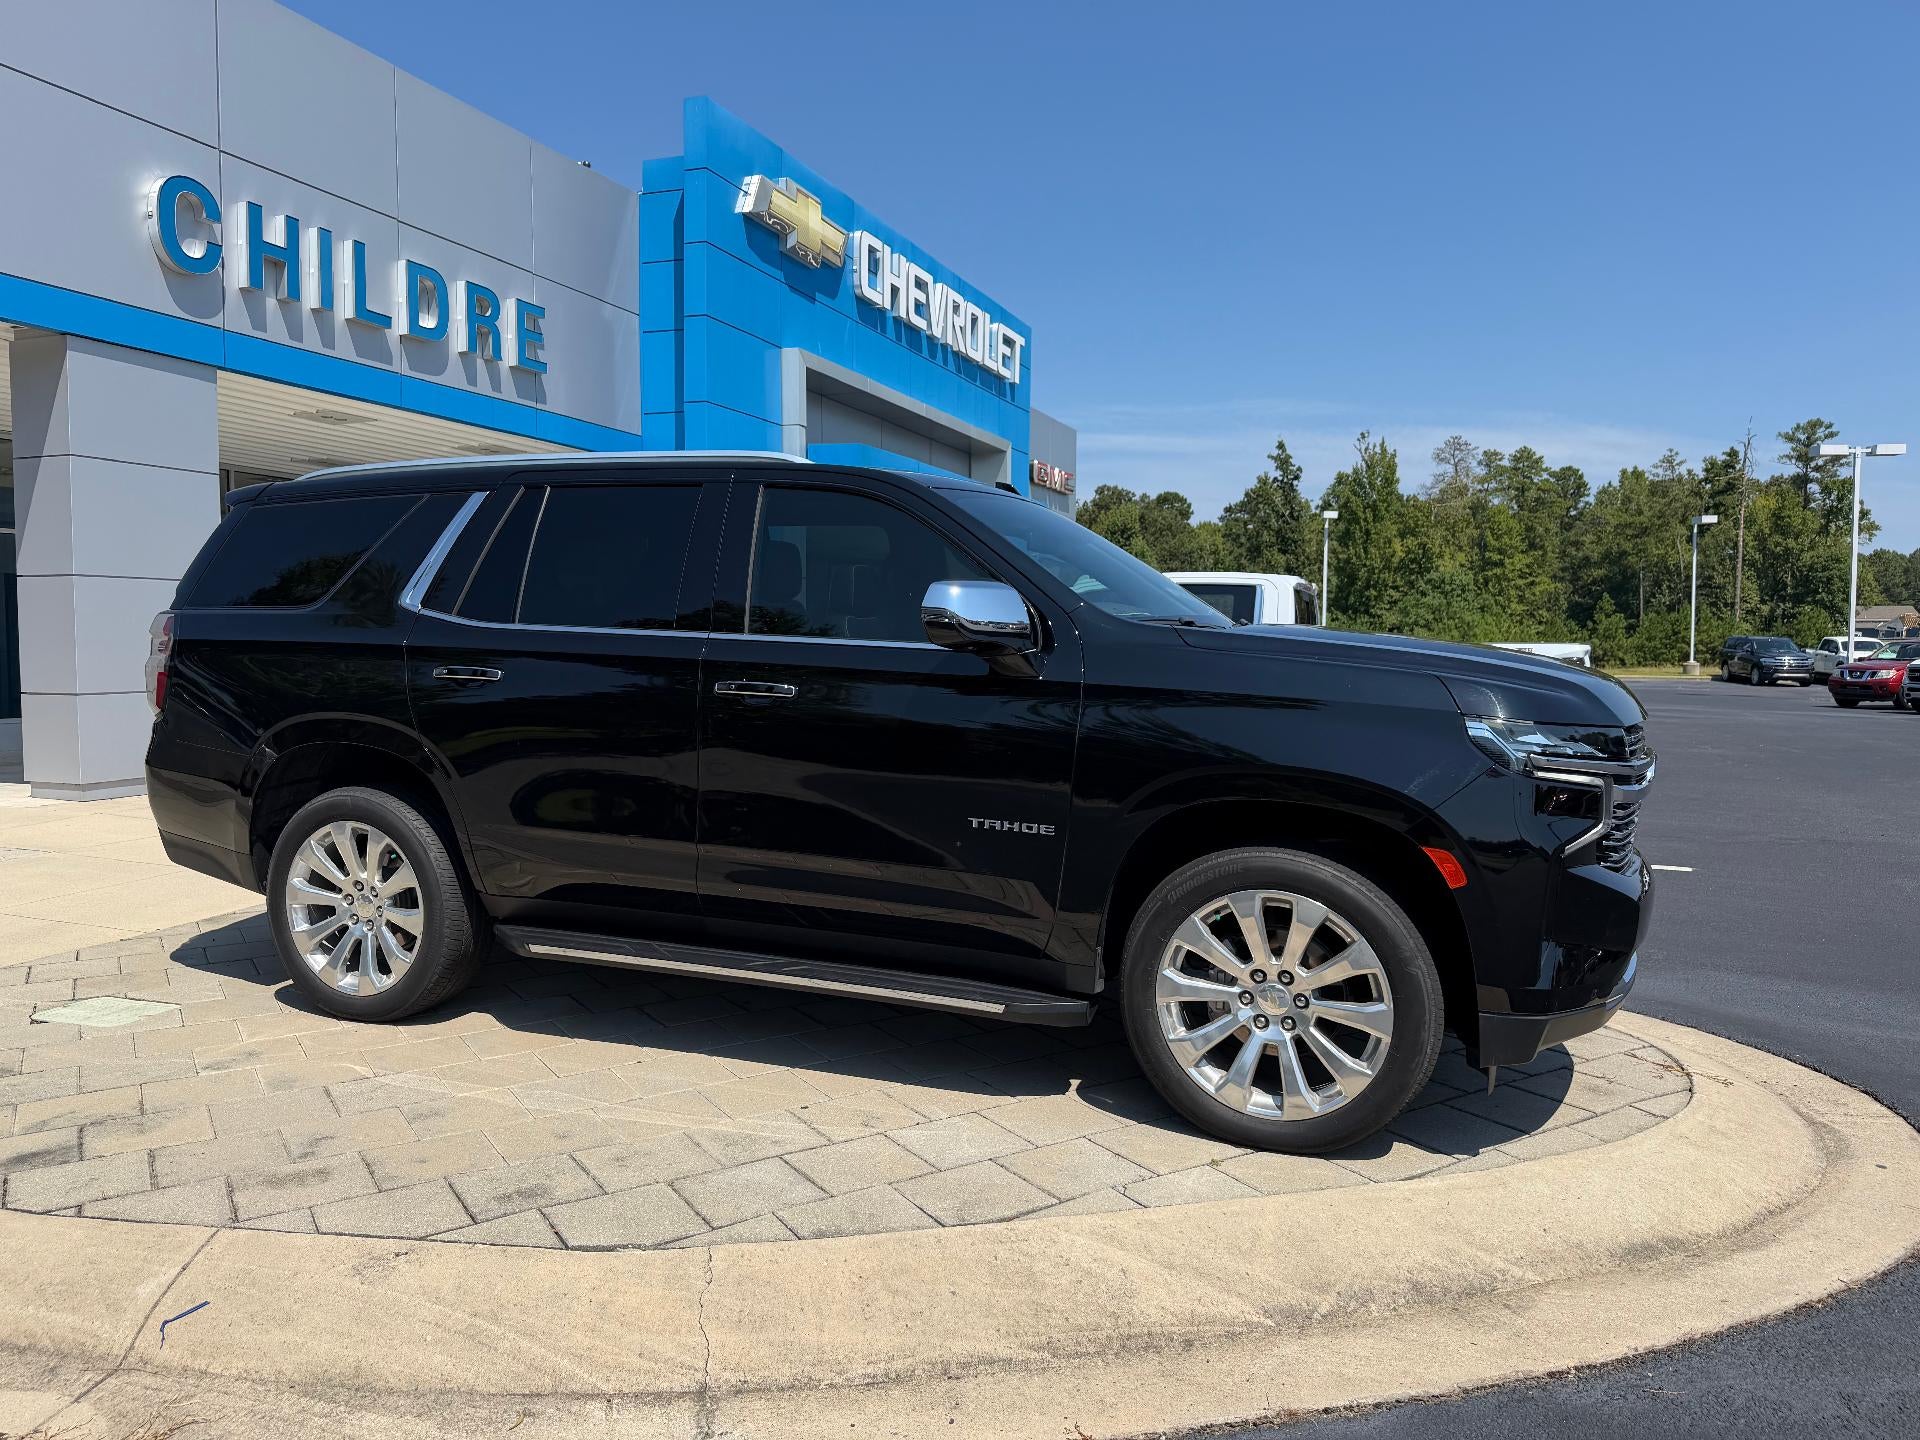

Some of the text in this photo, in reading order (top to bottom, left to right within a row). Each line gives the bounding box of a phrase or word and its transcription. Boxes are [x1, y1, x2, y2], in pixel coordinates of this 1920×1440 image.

[149, 174, 548, 374] CHILDRE
[853, 229, 1026, 385] CHEVROLET
[1033, 459, 1074, 496] GMC
[967, 817, 1055, 836] TAHOE
